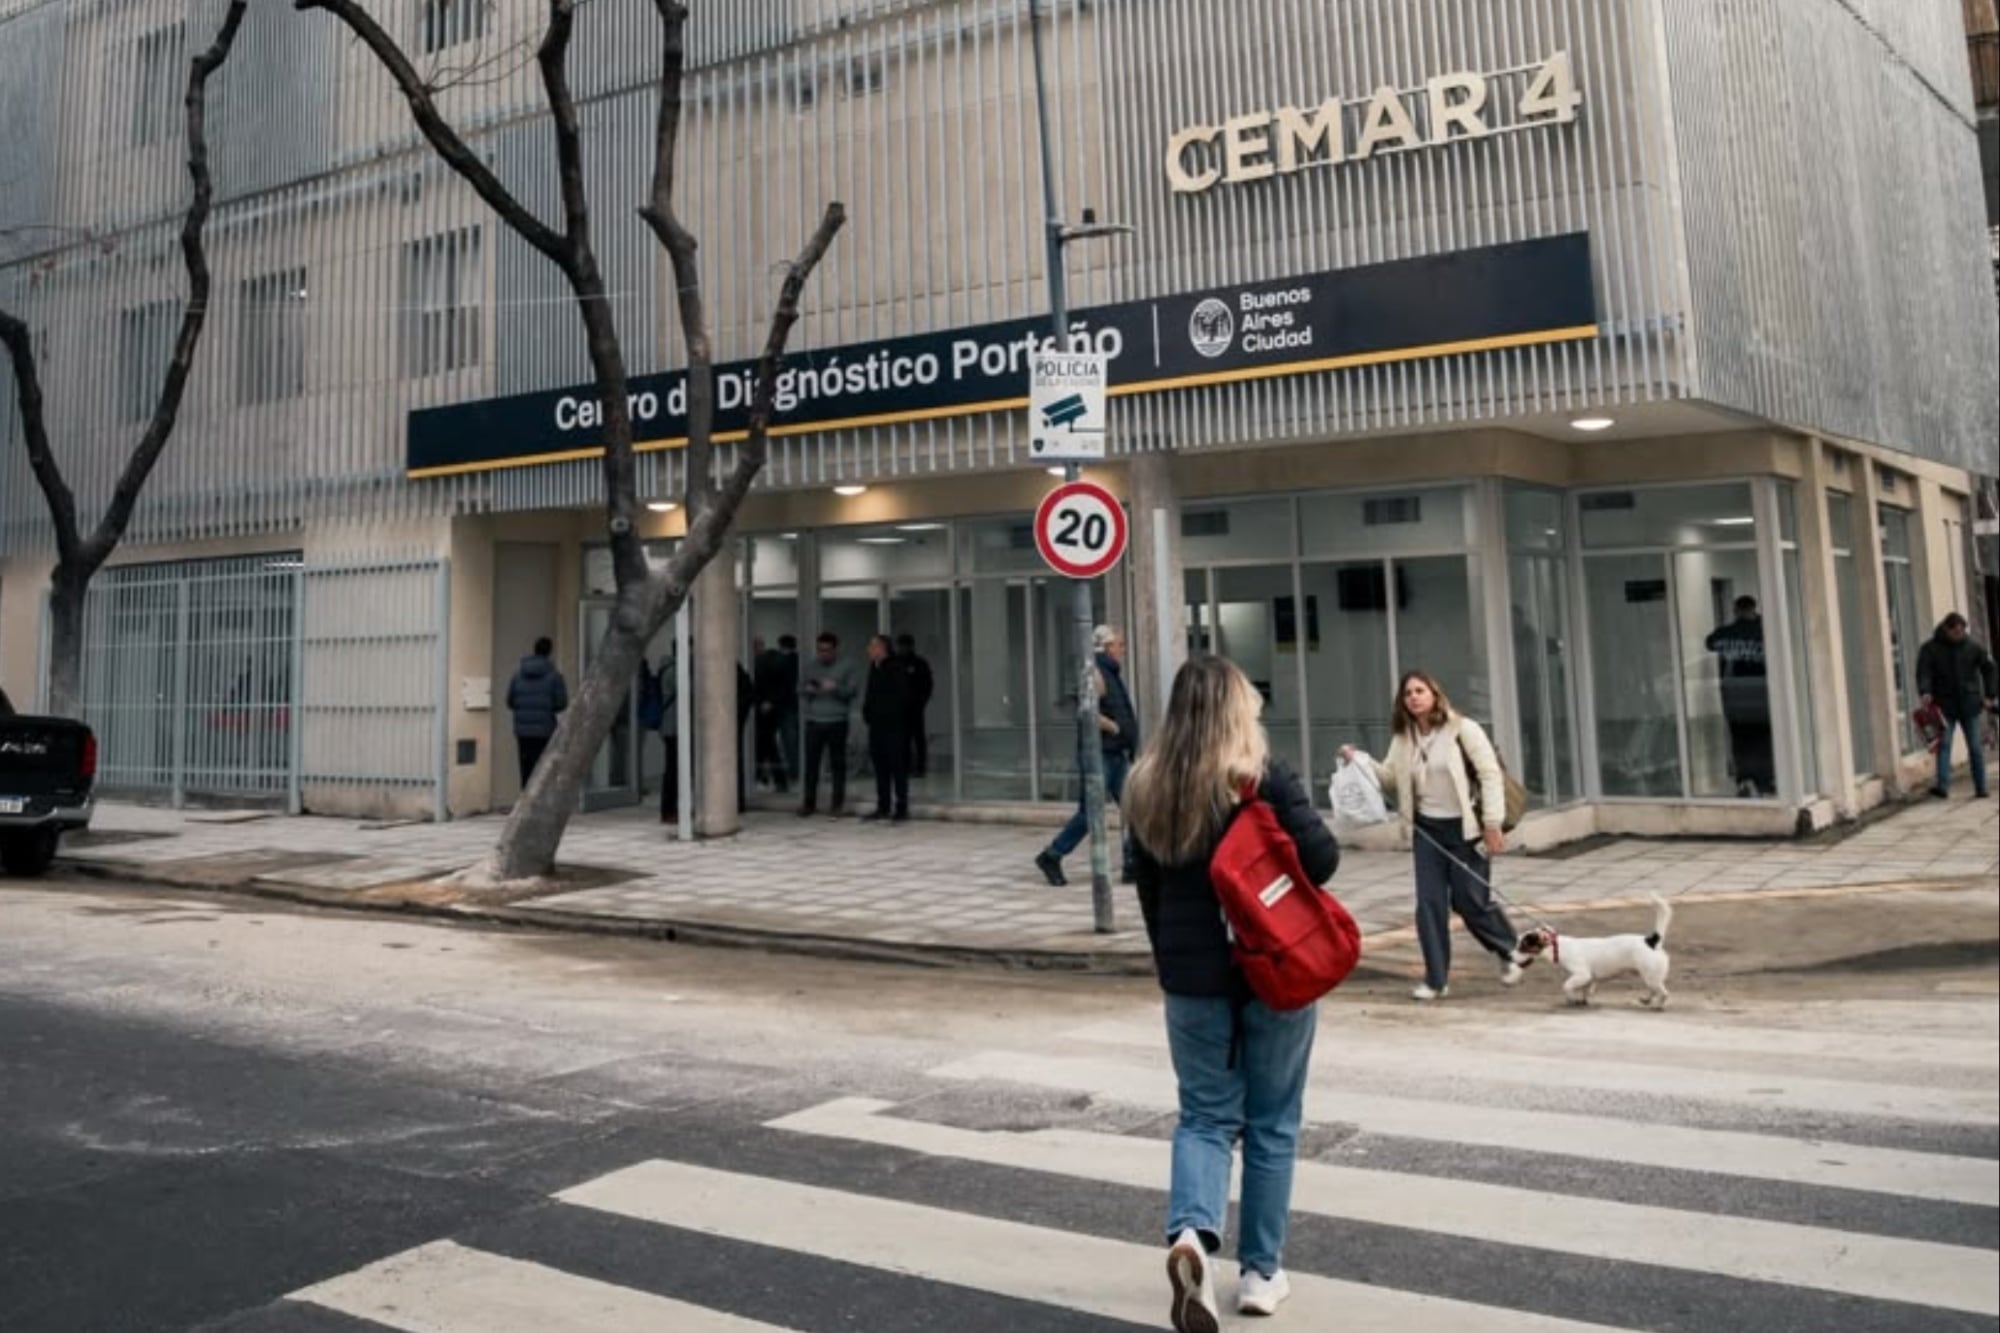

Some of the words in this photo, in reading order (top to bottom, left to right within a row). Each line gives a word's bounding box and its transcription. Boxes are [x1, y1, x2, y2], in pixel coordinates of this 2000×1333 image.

[1165, 70, 1488, 193] CEMAR
[1518, 50, 1582, 123] 4
[1240, 287, 1311, 310] Buenos
[1241, 311, 1294, 332] Aires
[1242, 325, 1313, 352] Ciudad
[554, 390, 659, 430] Cero
[717, 350, 939, 412] Dignóstico
[1054, 508, 1107, 551] 20
